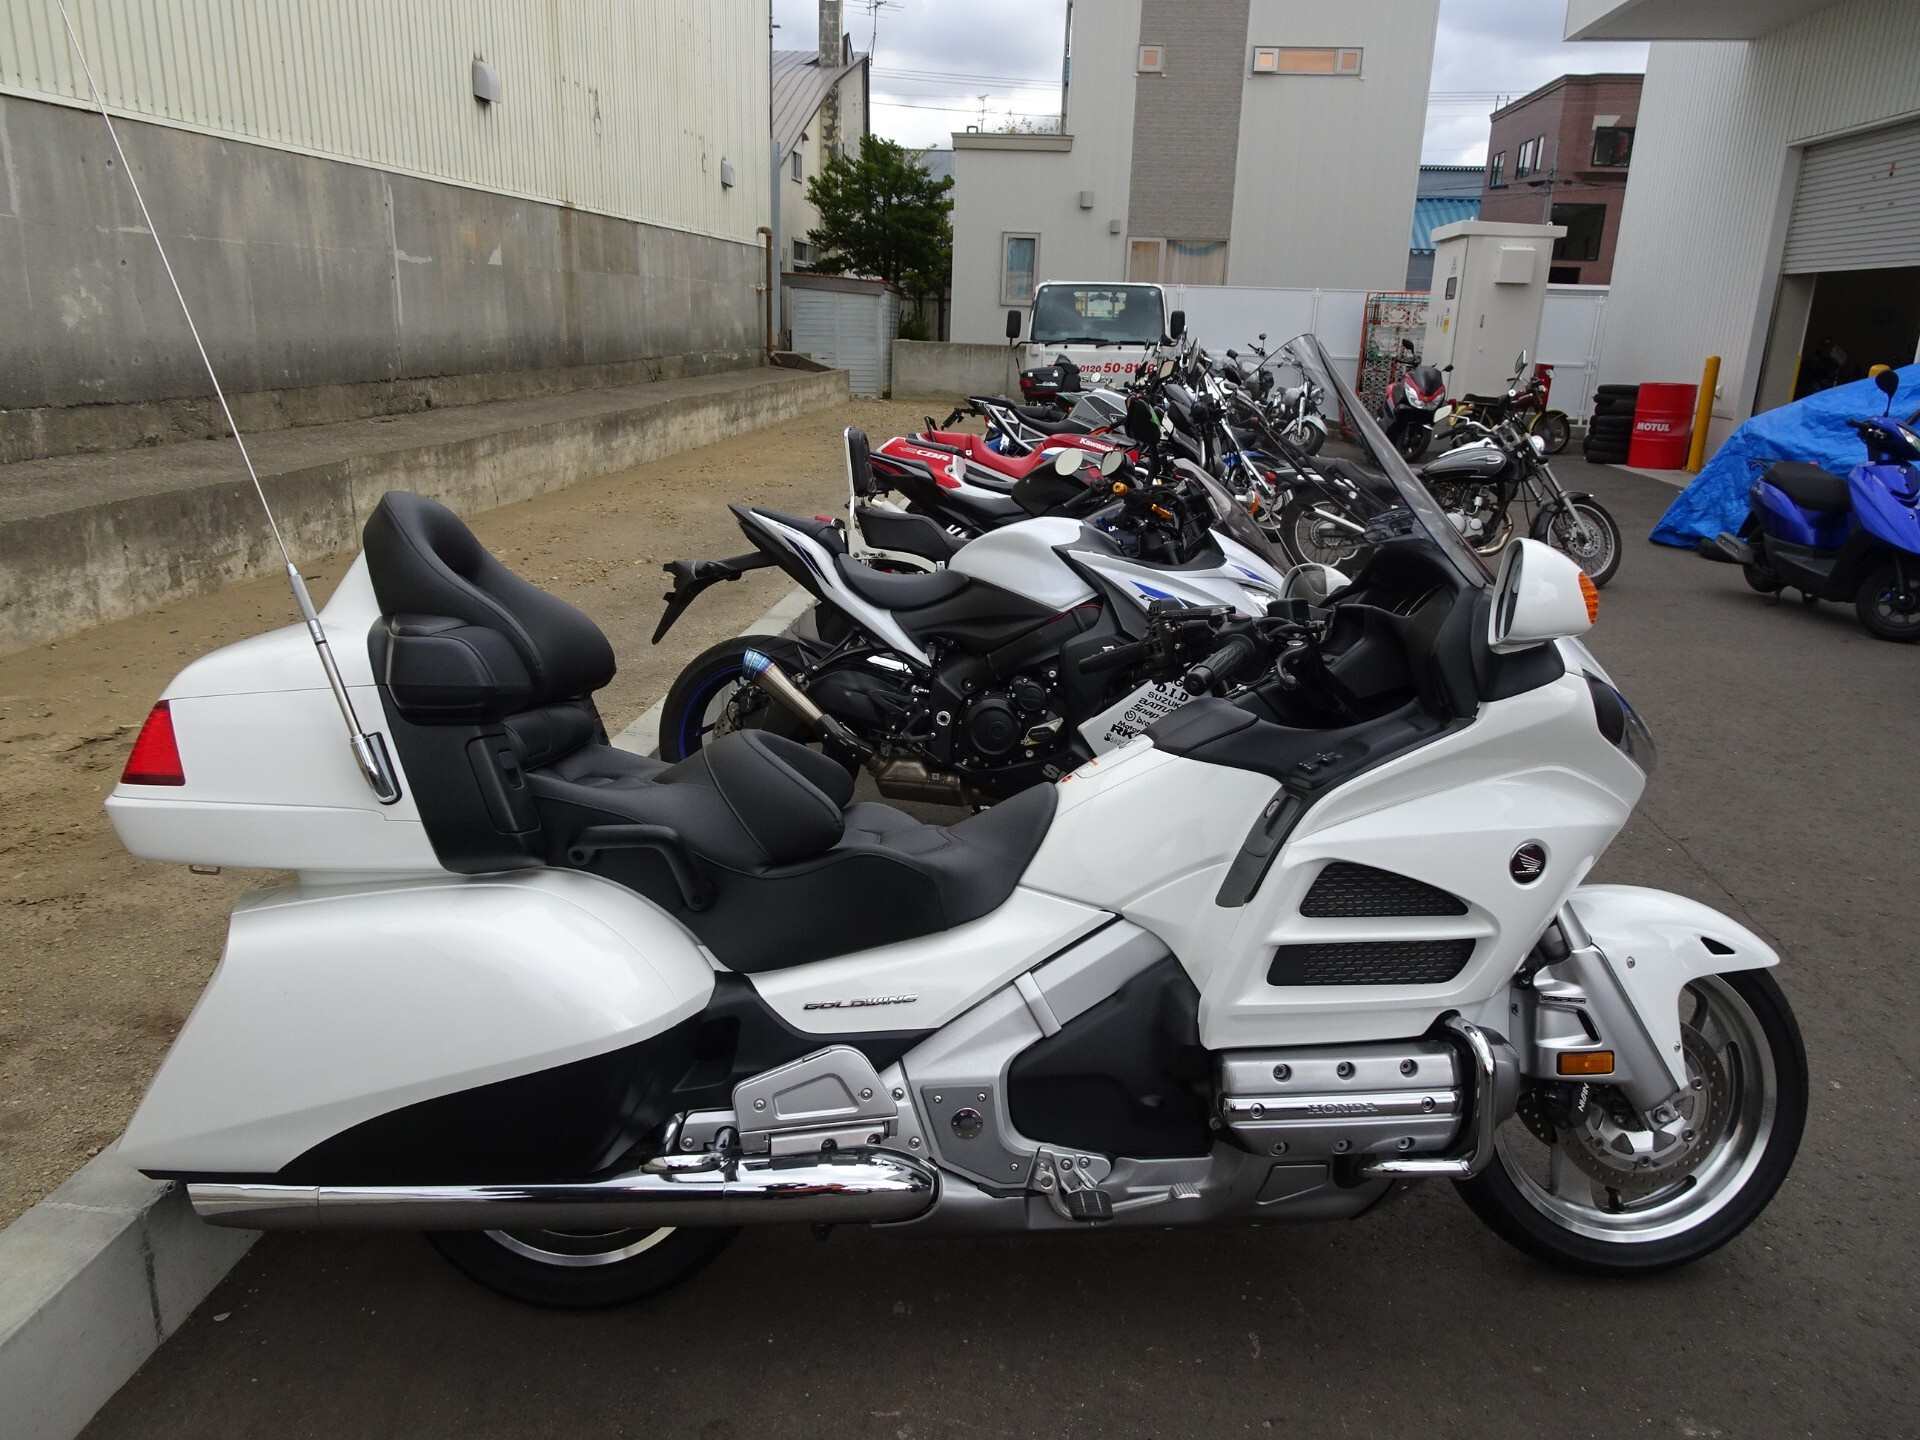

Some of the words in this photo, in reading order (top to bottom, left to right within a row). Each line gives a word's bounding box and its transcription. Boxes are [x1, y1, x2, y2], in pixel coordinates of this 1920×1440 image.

[1080, 365, 1102, 373] 0120
[1636, 422, 1670, 432] MOTUL
[1147, 691, 1183, 709] SUZUK
[1154, 683, 1189, 702] D.I.D
[1138, 697, 1174, 714] BATTLA
[1307, 1102, 1379, 1115] HONDA
